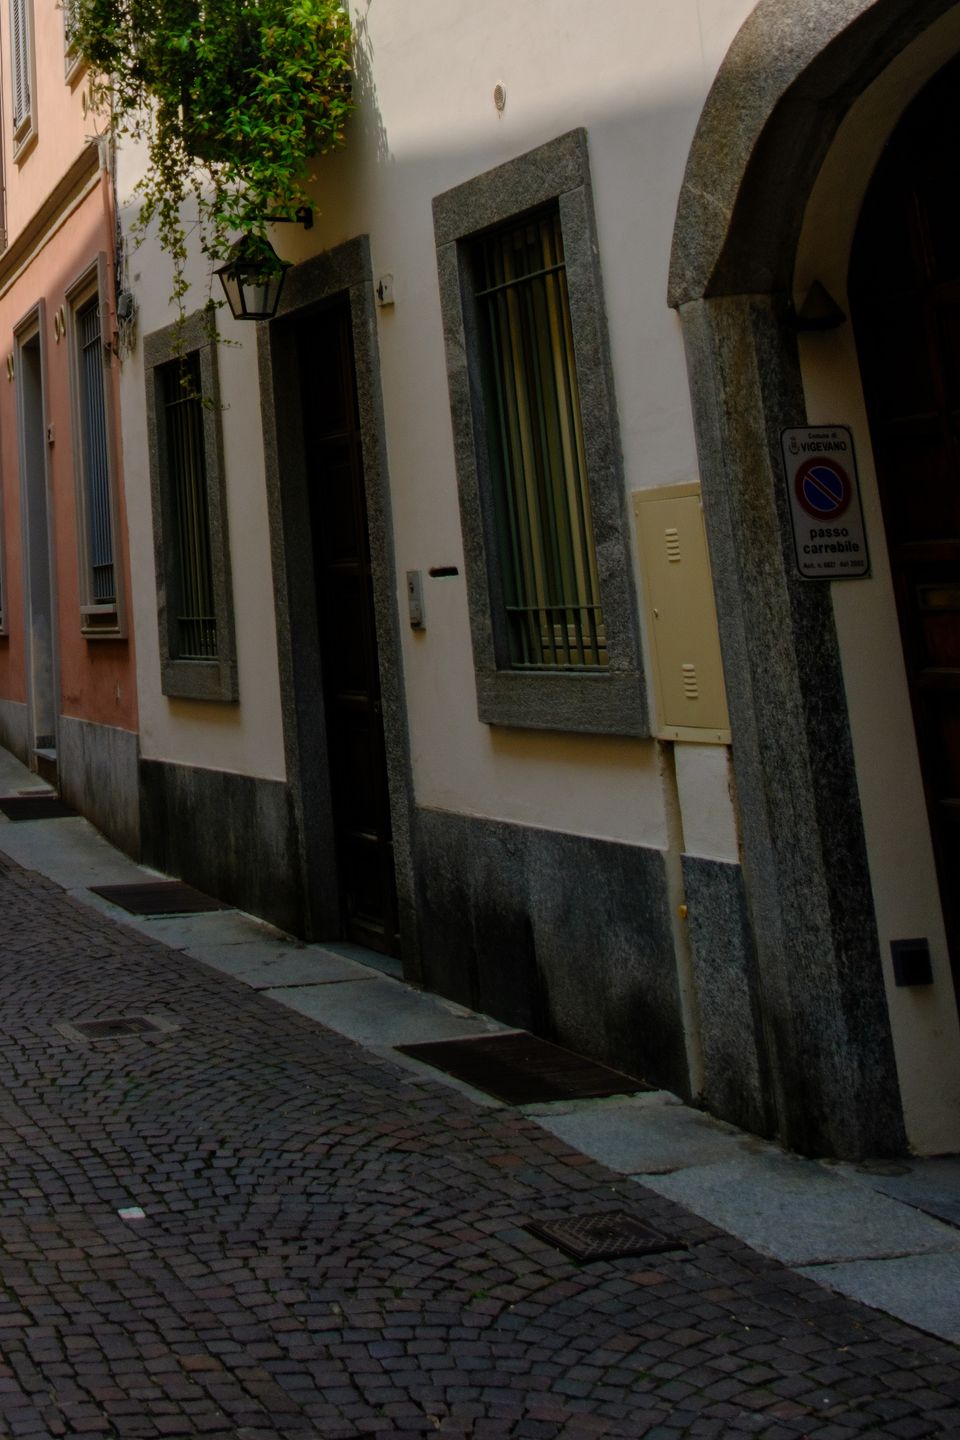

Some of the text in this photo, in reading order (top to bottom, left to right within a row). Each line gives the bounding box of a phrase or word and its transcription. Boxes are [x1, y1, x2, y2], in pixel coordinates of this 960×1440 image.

[800, 441, 847, 452] VIGEVANO
[809, 528, 849, 541] passo
[803, 541, 860, 554] carrabile
